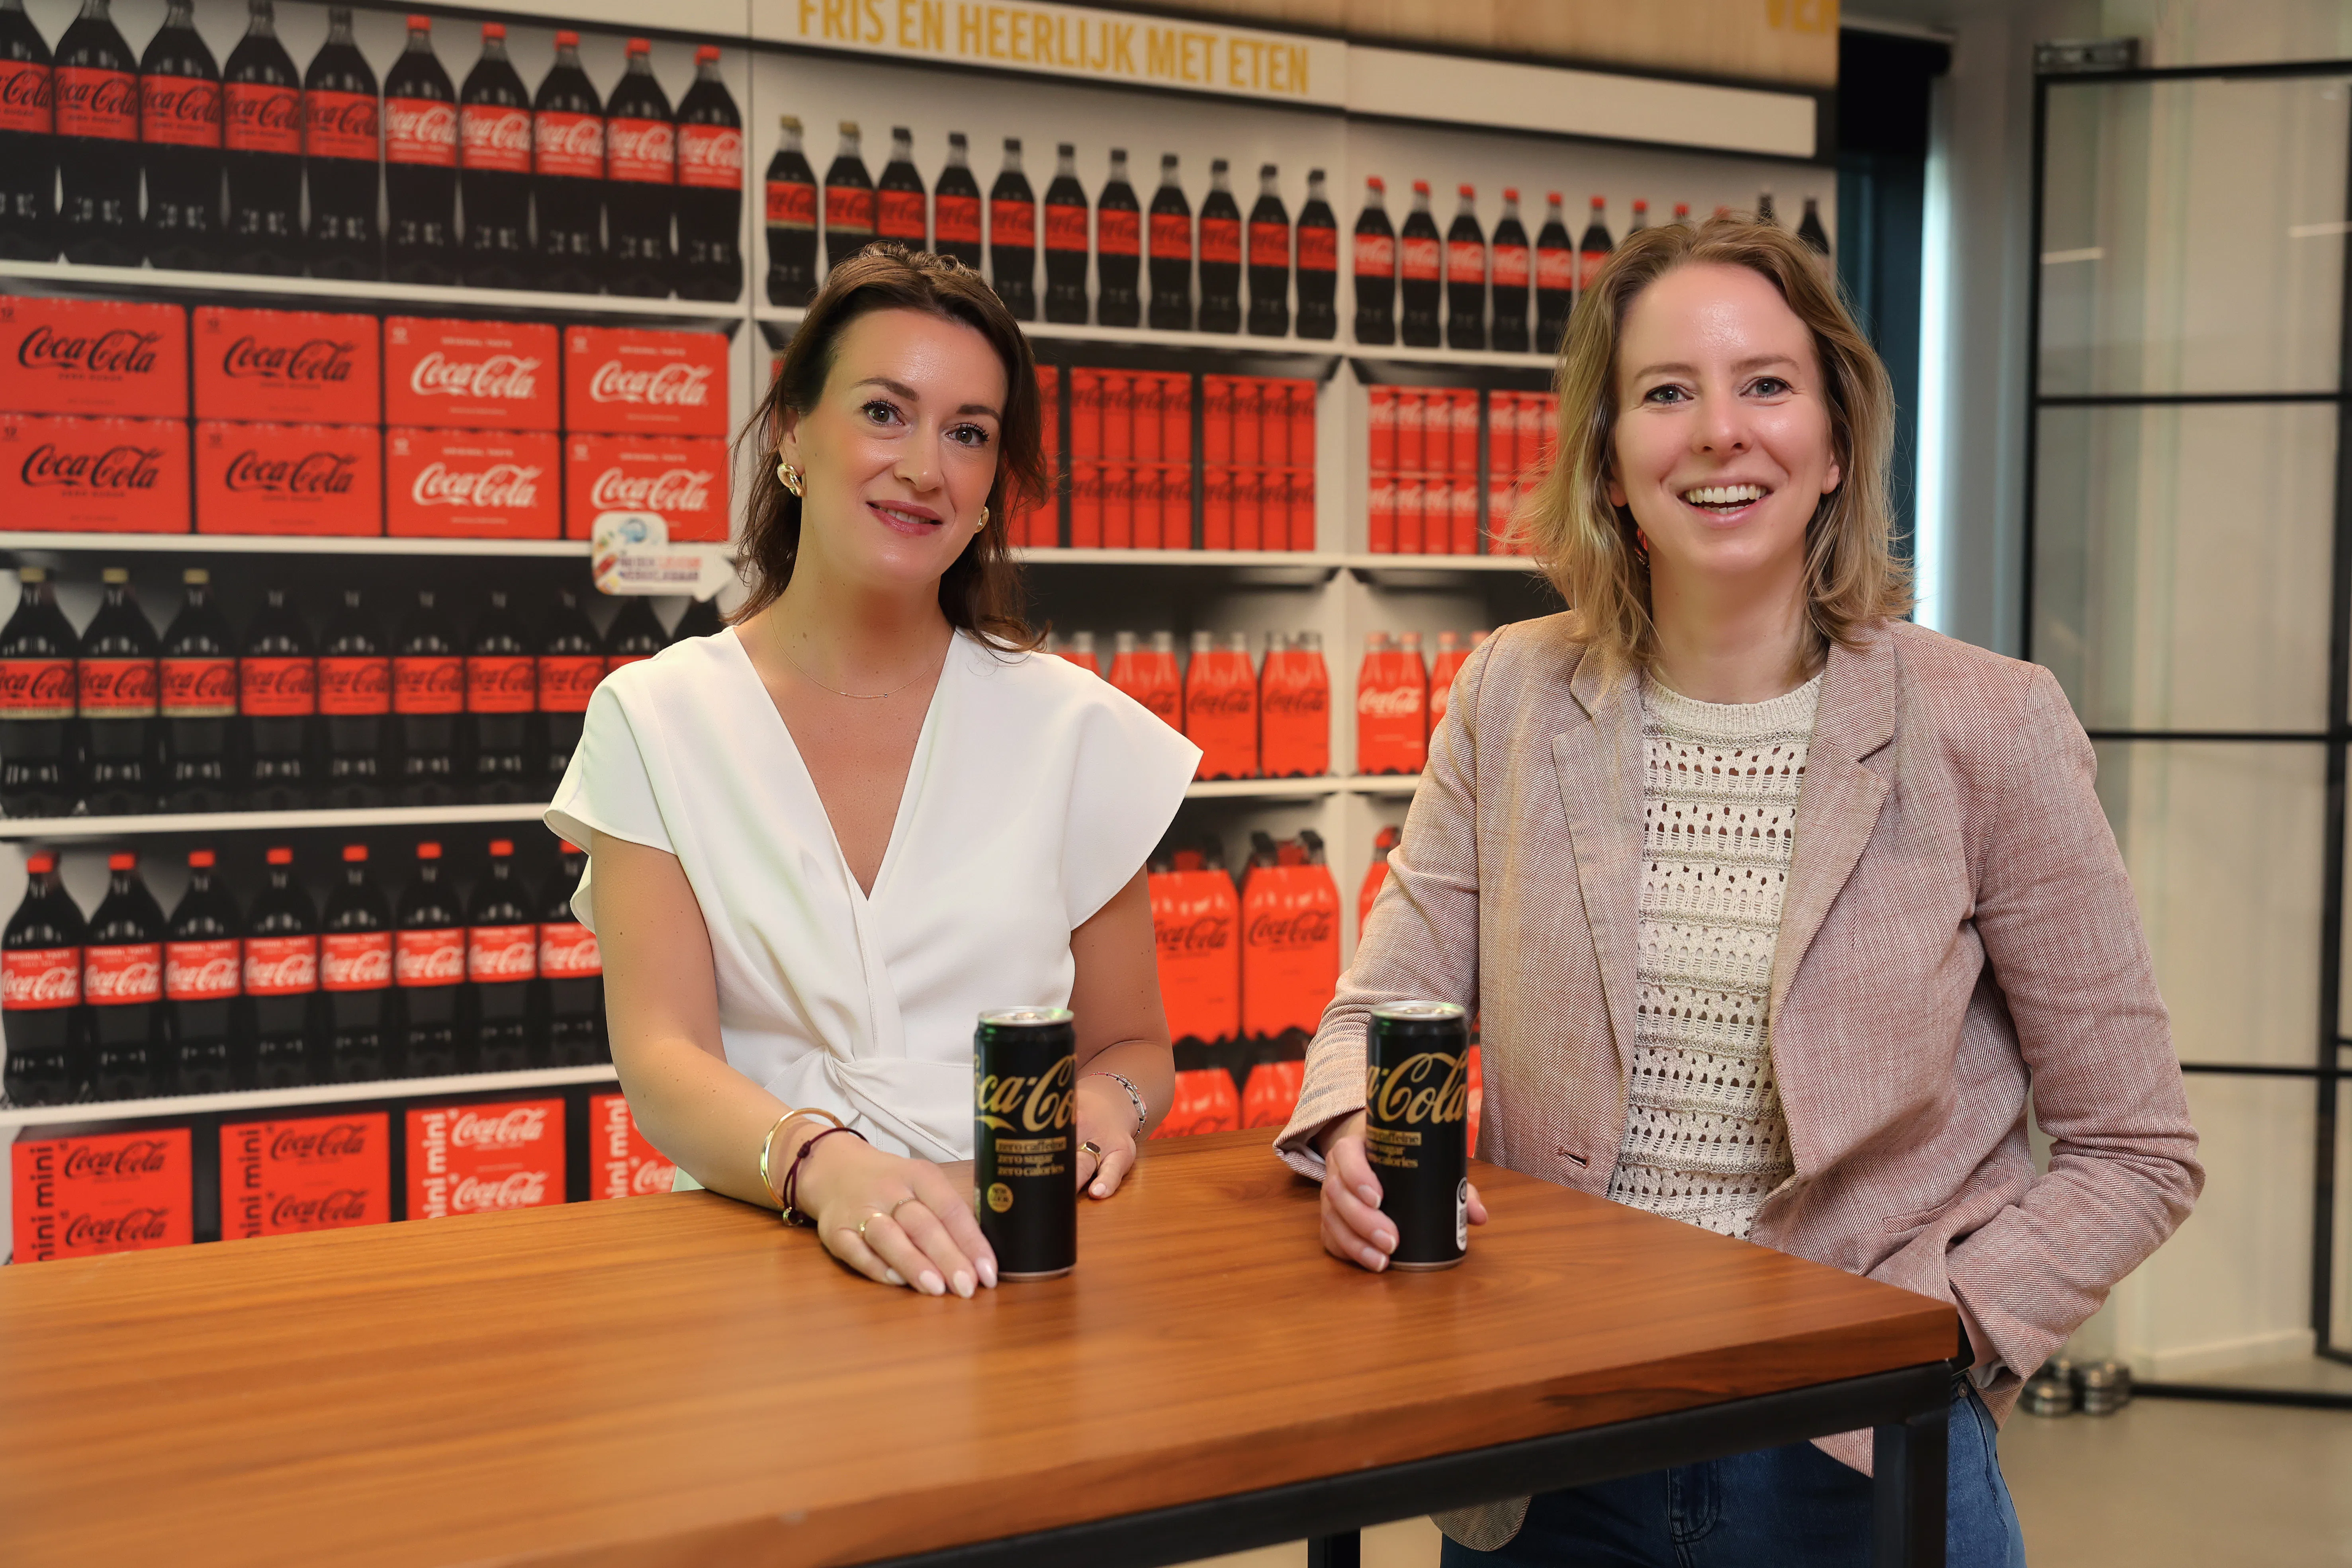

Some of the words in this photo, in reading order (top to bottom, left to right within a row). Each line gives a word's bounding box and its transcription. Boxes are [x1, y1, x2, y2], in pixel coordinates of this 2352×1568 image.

[799, 0, 886, 45] FRIS
[897, 0, 944, 52] EN
[959, 5, 1136, 75] HEERLIJK
[1147, 26, 1218, 82] MET
[1228, 37, 1308, 94] ETEN
[237, 1129, 262, 1189] mini
[421, 1112, 447, 1174] mini
[29, 1146, 54, 1208] mini
[604, 1160, 629, 1198] ini
